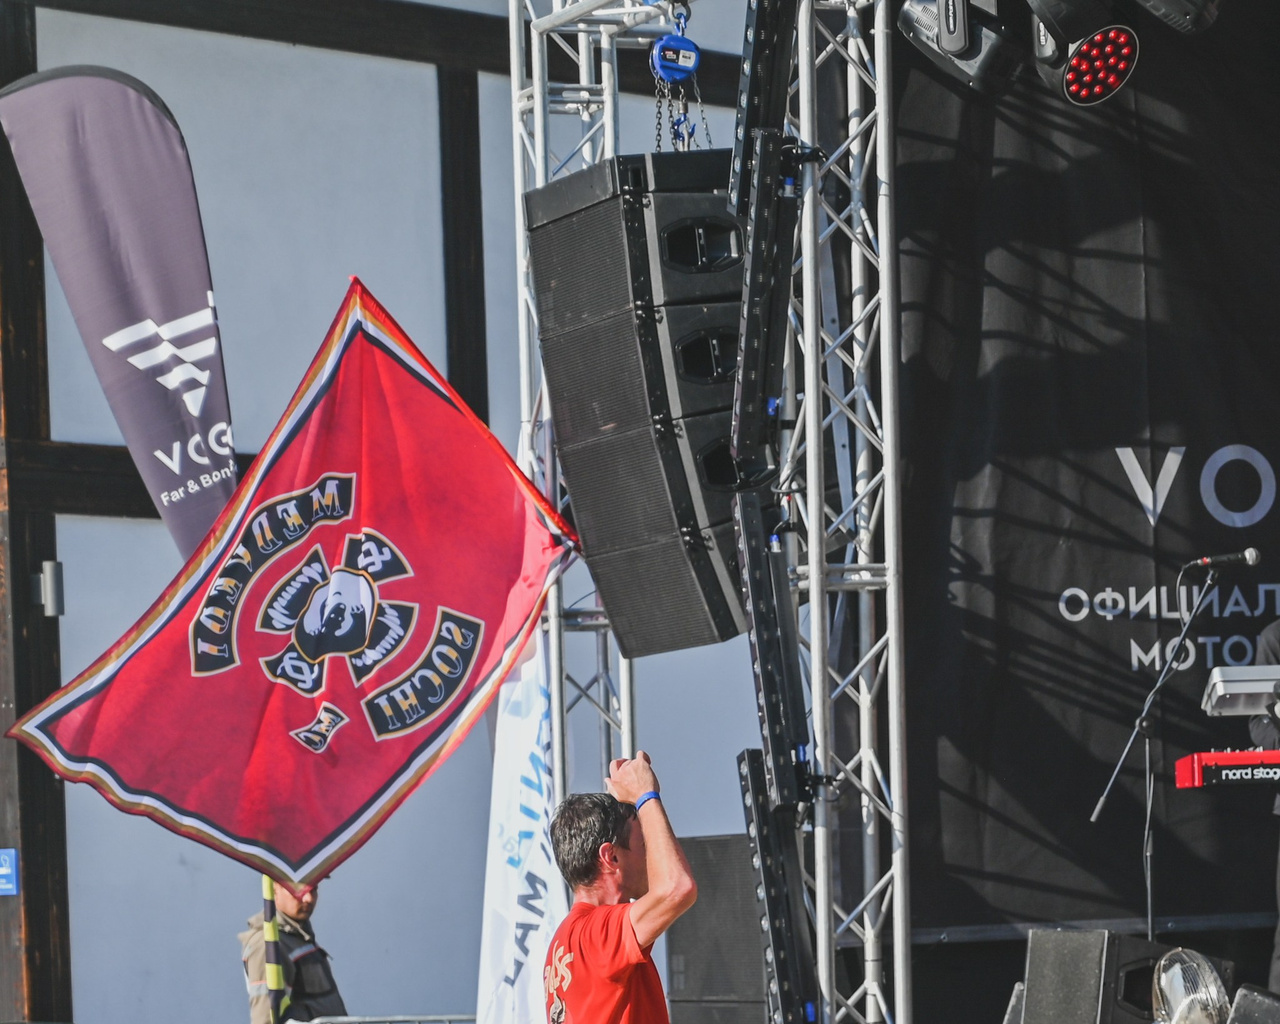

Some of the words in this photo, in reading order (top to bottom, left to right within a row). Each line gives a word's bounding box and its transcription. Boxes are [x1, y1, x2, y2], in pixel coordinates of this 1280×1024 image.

[160, 486, 184, 507] Far
[186, 479, 200, 494] &
[1221, 766, 1252, 780] nord
